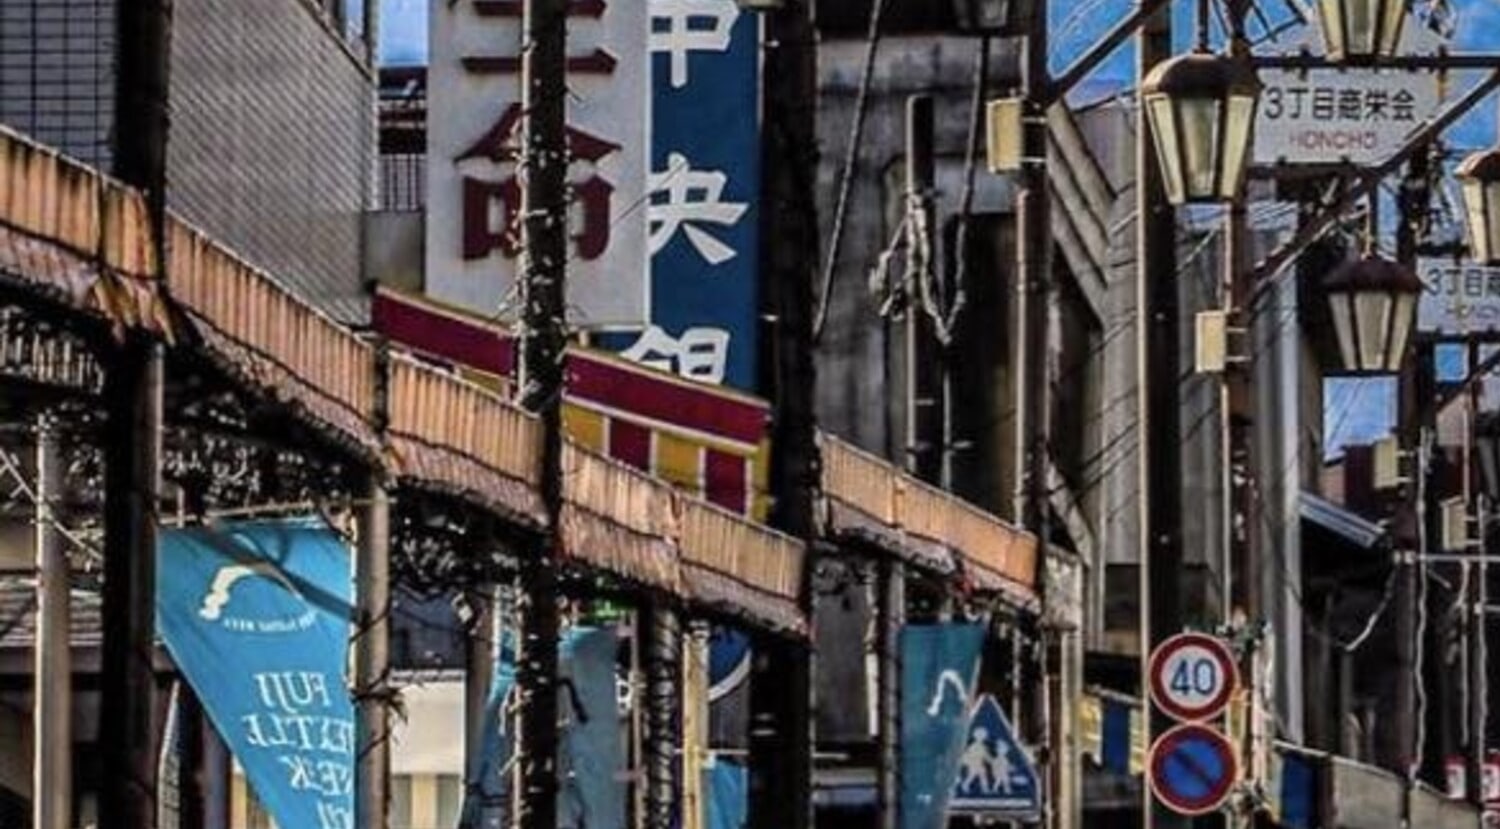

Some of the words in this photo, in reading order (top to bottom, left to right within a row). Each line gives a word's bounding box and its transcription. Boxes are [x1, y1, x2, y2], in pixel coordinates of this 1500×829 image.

[1264, 86, 1416, 121] 3丁目商栄会
[1171, 660, 1217, 695] 40
